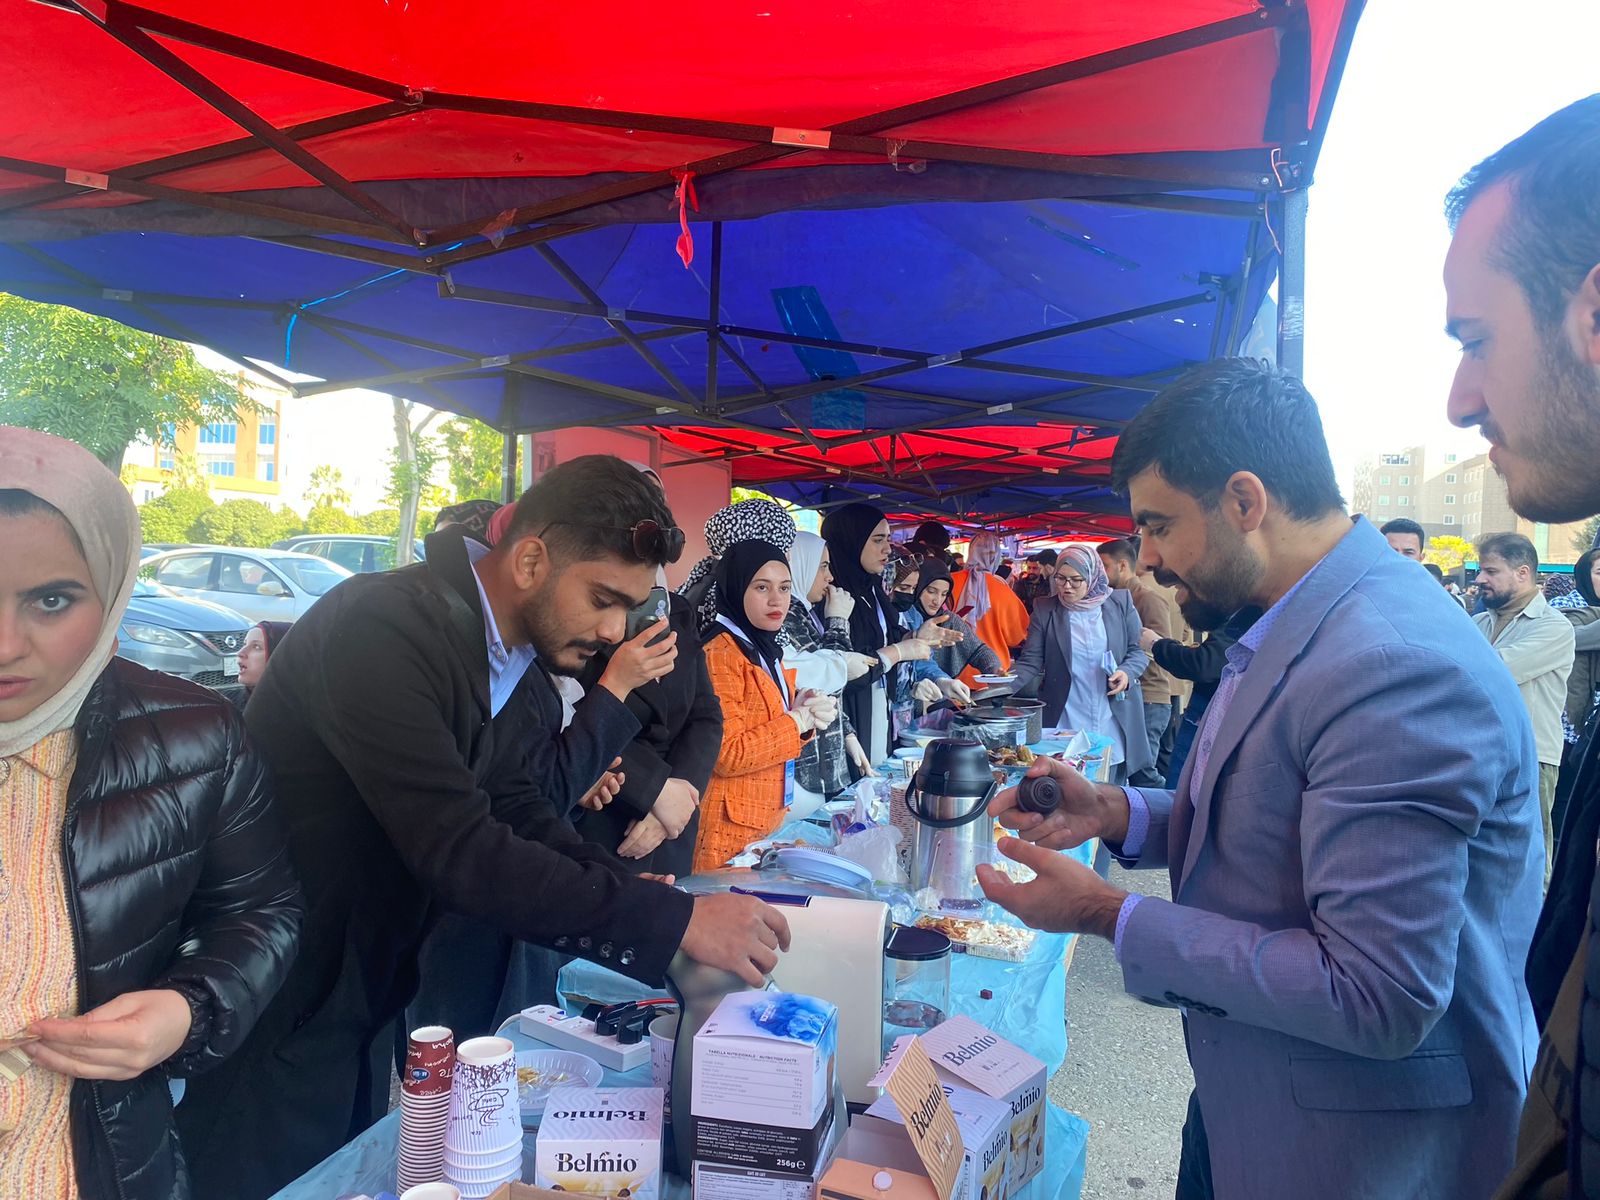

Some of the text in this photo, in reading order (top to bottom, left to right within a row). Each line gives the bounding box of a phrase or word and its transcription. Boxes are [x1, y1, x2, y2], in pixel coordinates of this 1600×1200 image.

[942, 1034, 998, 1067] Belmio
[553, 1110, 649, 1121] Belmio
[910, 1082, 943, 1140] Belmio
[555, 1152, 637, 1172] Belmio
[776, 1159, 796, 1169] 256g
[983, 1130, 1008, 1172] Belmio
